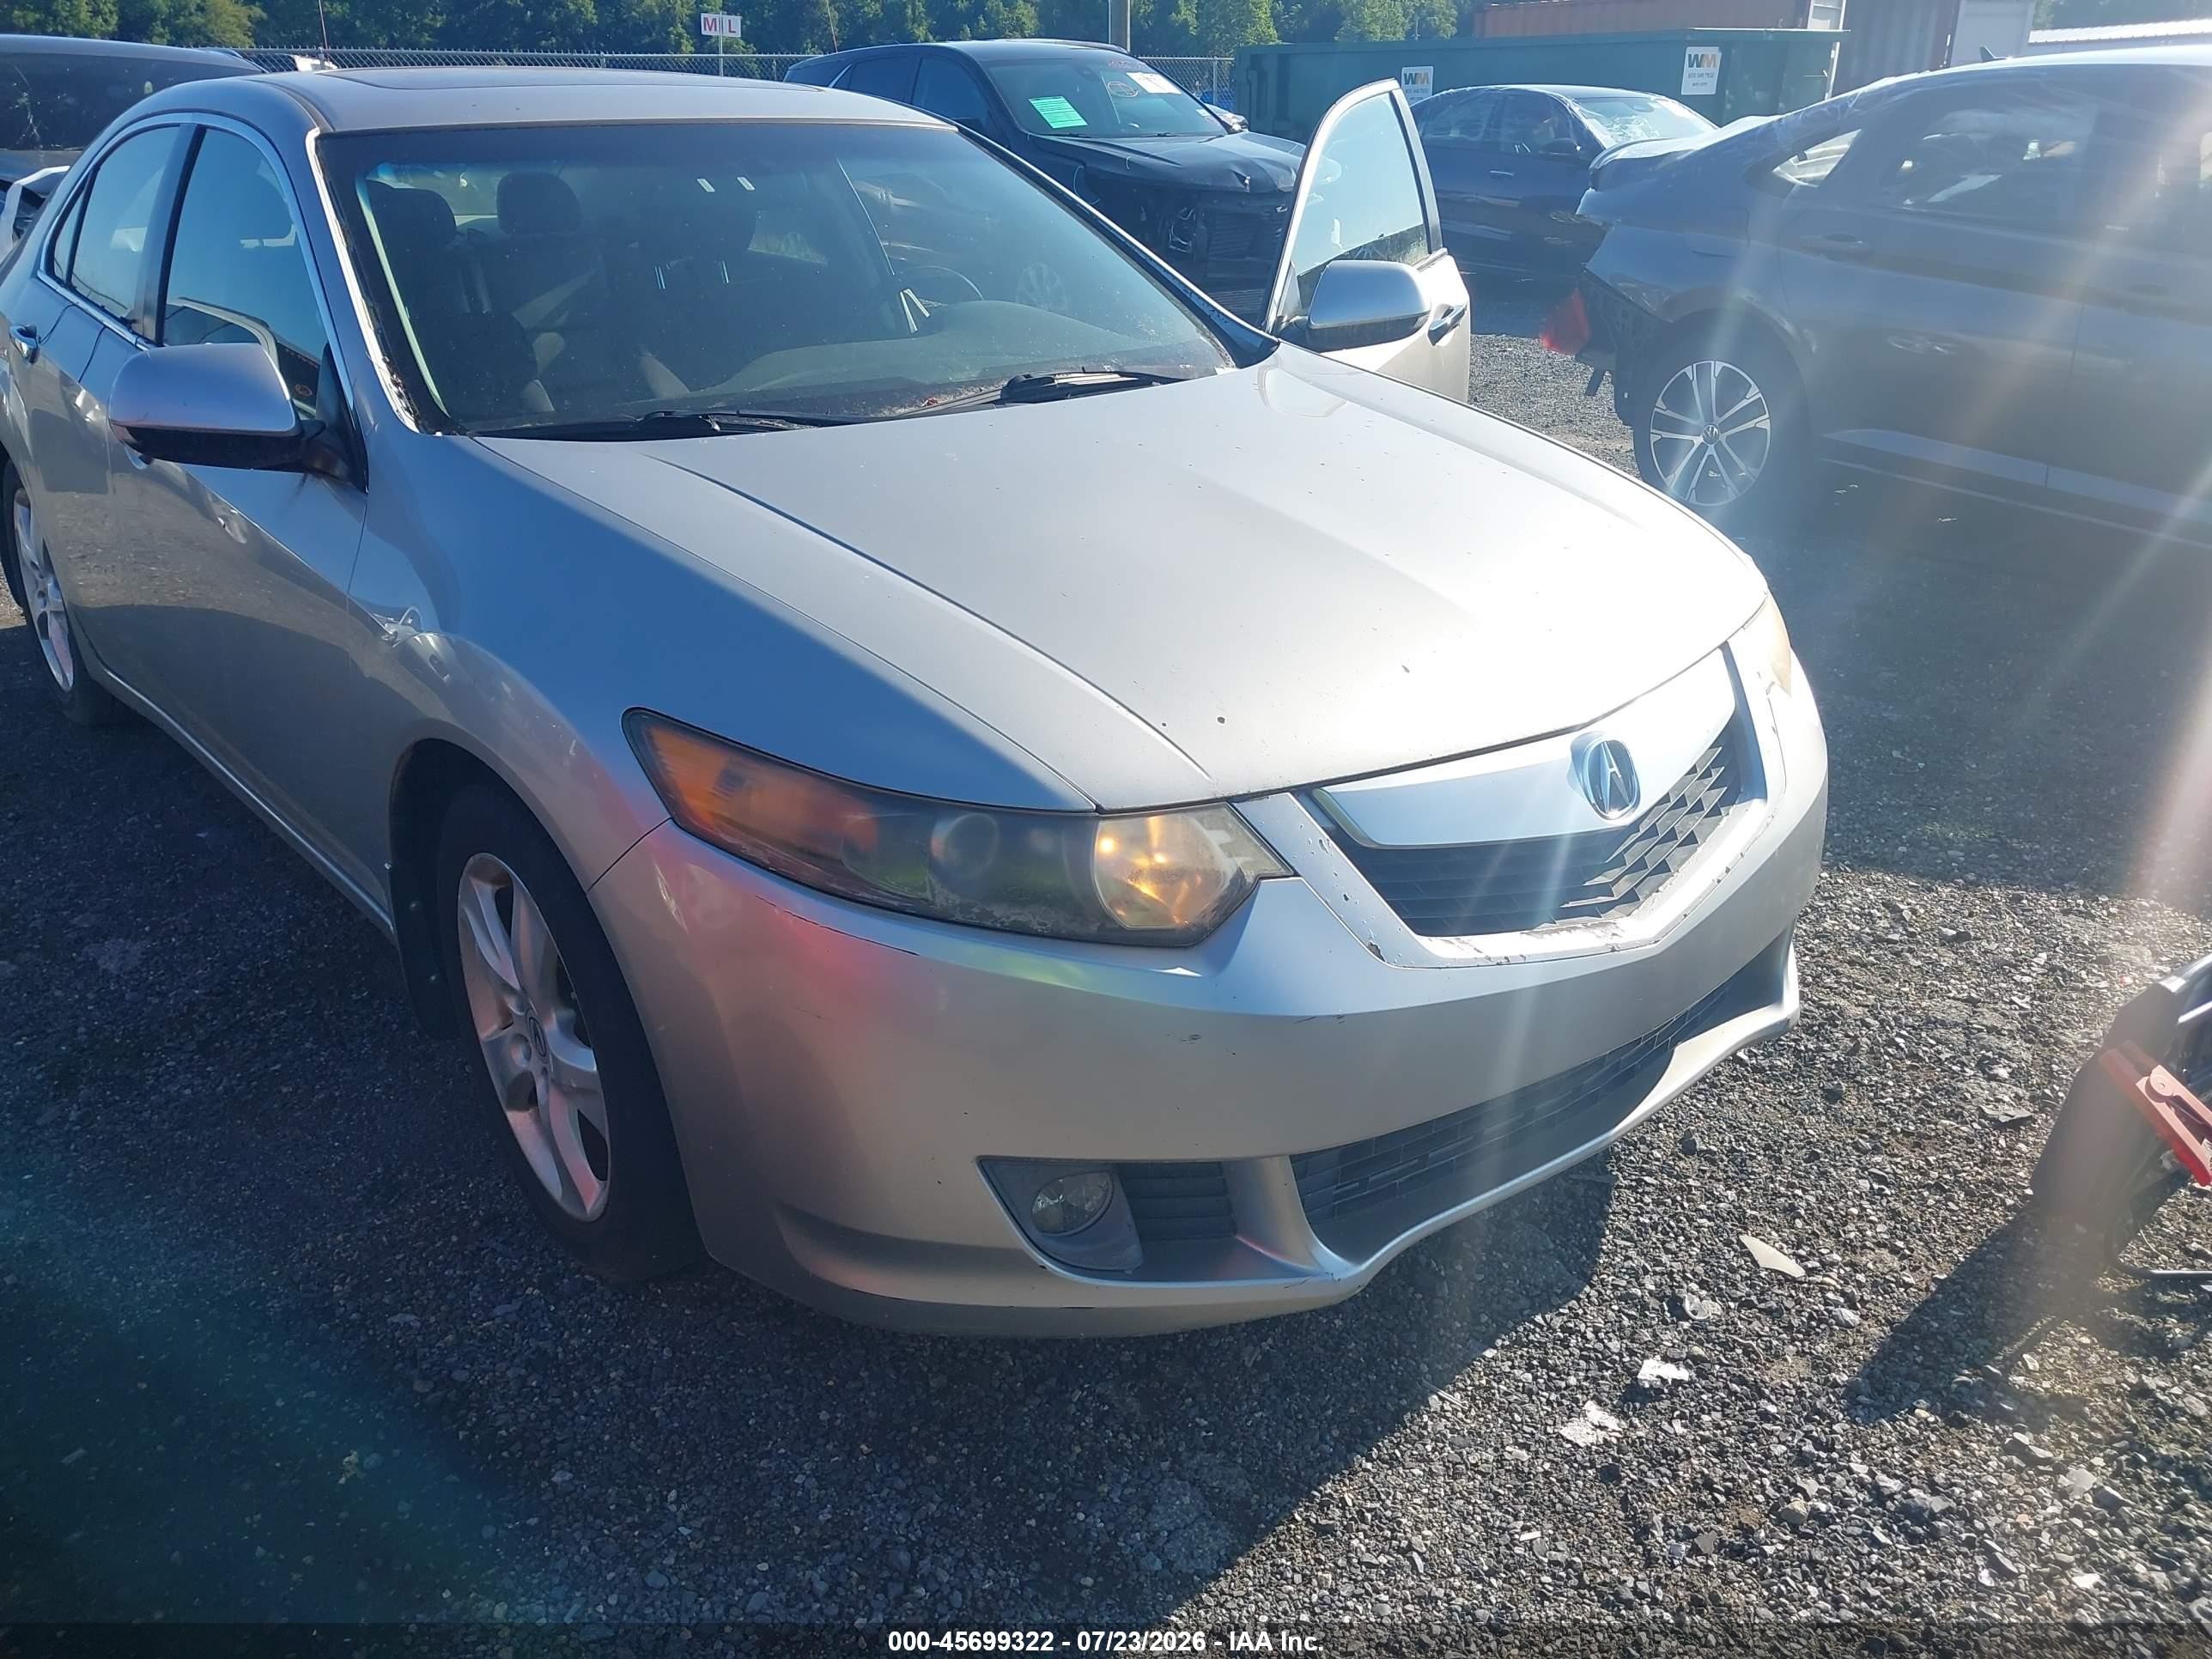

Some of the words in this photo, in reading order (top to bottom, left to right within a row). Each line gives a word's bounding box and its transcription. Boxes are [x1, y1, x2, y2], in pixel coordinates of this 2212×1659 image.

[703, 16, 717, 32] M
[728, 19, 737, 33] L
[1687, 53, 1717, 68] WM
[1403, 72, 1429, 85] WM
